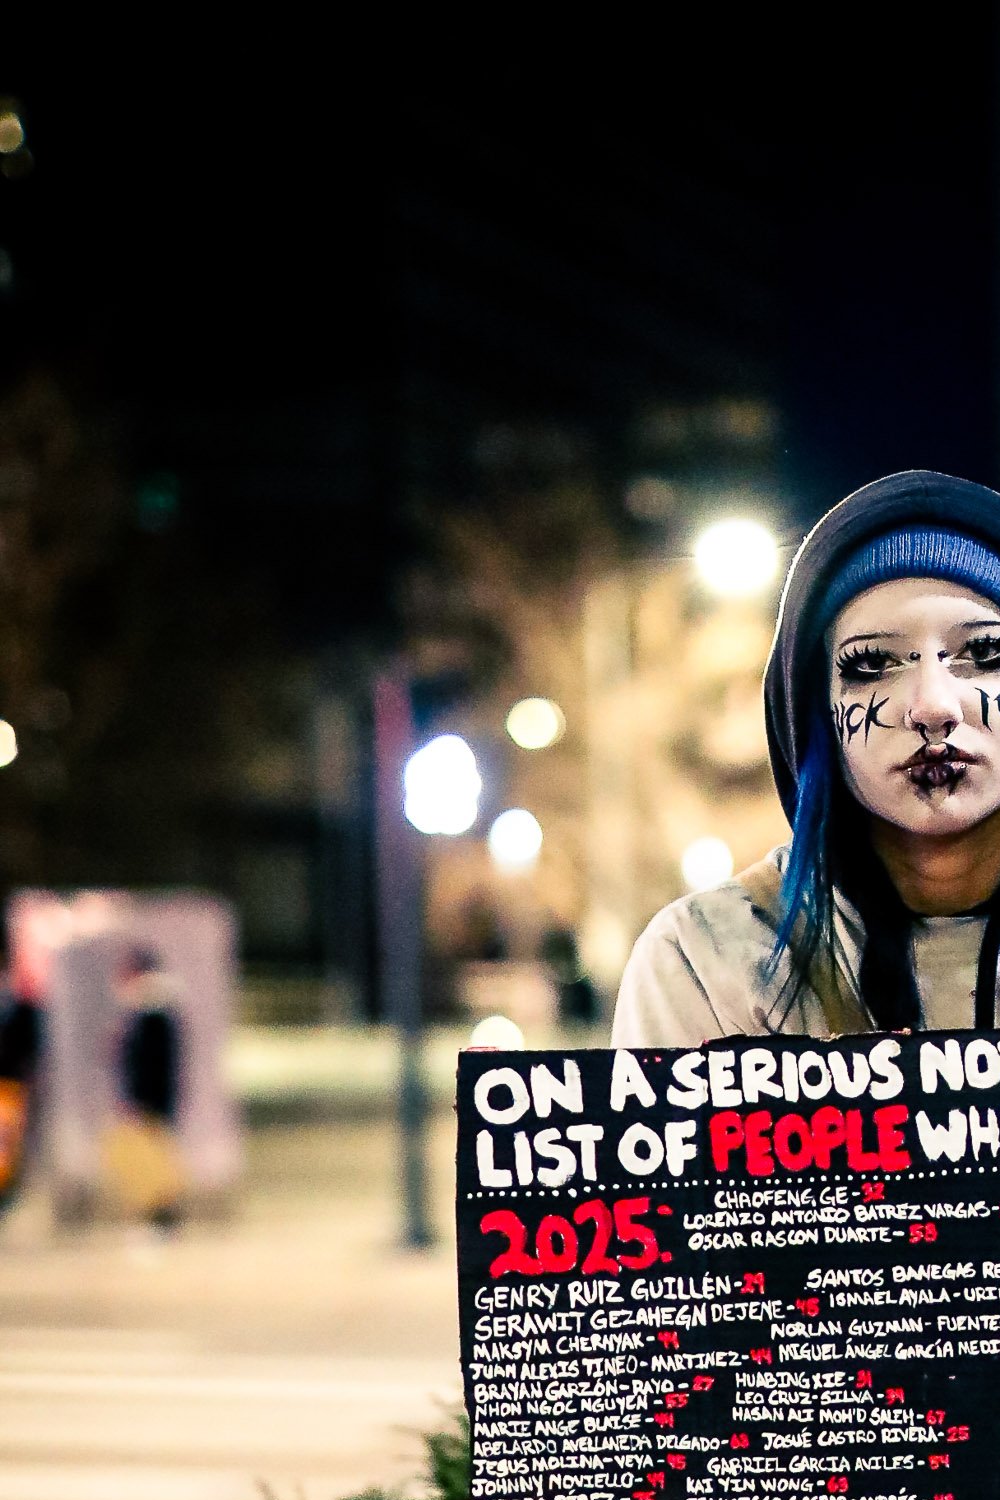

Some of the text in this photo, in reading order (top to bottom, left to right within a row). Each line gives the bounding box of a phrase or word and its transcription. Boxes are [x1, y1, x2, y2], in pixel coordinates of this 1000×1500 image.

[474, 1059, 583, 1124] ON
[607, 1046, 660, 1111] A
[667, 1038, 904, 1109] SERIOUS
[476, 1124, 604, 1187] LIST
[618, 1120, 697, 1176] OF
[709, 1105, 911, 1176] PEOPLE
[683, 1211, 765, 1230] LORENZO
[771, 1207, 850, 1226] ANTONIO
[688, 1232, 747, 1251] OSCAR
[807, 1269, 884, 1288] SANTOS
[892, 1262, 976, 1282] BANEGAS
[475, 1283, 559, 1313] GENRY
[568, 1280, 624, 1308] RUIZ
[830, 1290, 896, 1307] ISMAEL
[475, 1312, 585, 1342] SERAWIT
[771, 1321, 842, 1340] NORLAN
[474, 1339, 552, 1362] MAKSYM
[779, 1343, 843, 1362] MIGUEL
[845, 1338, 891, 1359] ÁNGEL
[895, 1339, 953, 1360] GARCÍA
[469, 1363, 516, 1380] JUAN
[520, 1360, 579, 1380] ALEXIS
[736, 1372, 810, 1389] HUABING
[474, 1381, 543, 1403] BRAYAN
[736, 1392, 764, 1404] LEO
[475, 1402, 521, 1421] NHON
[527, 1400, 577, 1415] NGOC
[733, 1406, 784, 1422] HASAN
[474, 1421, 531, 1438] MARIE
[584, 1414, 641, 1433] BLAISE
[474, 1439, 557, 1457] ABELARDO
[762, 1427, 812, 1450] JOSUÉ
[817, 1430, 876, 1446] CASTRO
[473, 1458, 529, 1477] JESUS
[707, 1457, 786, 1476] GABRIEL
[855, 1455, 914, 1471] AVILES
[472, 1474, 543, 1496] JOHNNY
[687, 1477, 713, 1495] KAI
[718, 1477, 755, 1492] YIN
